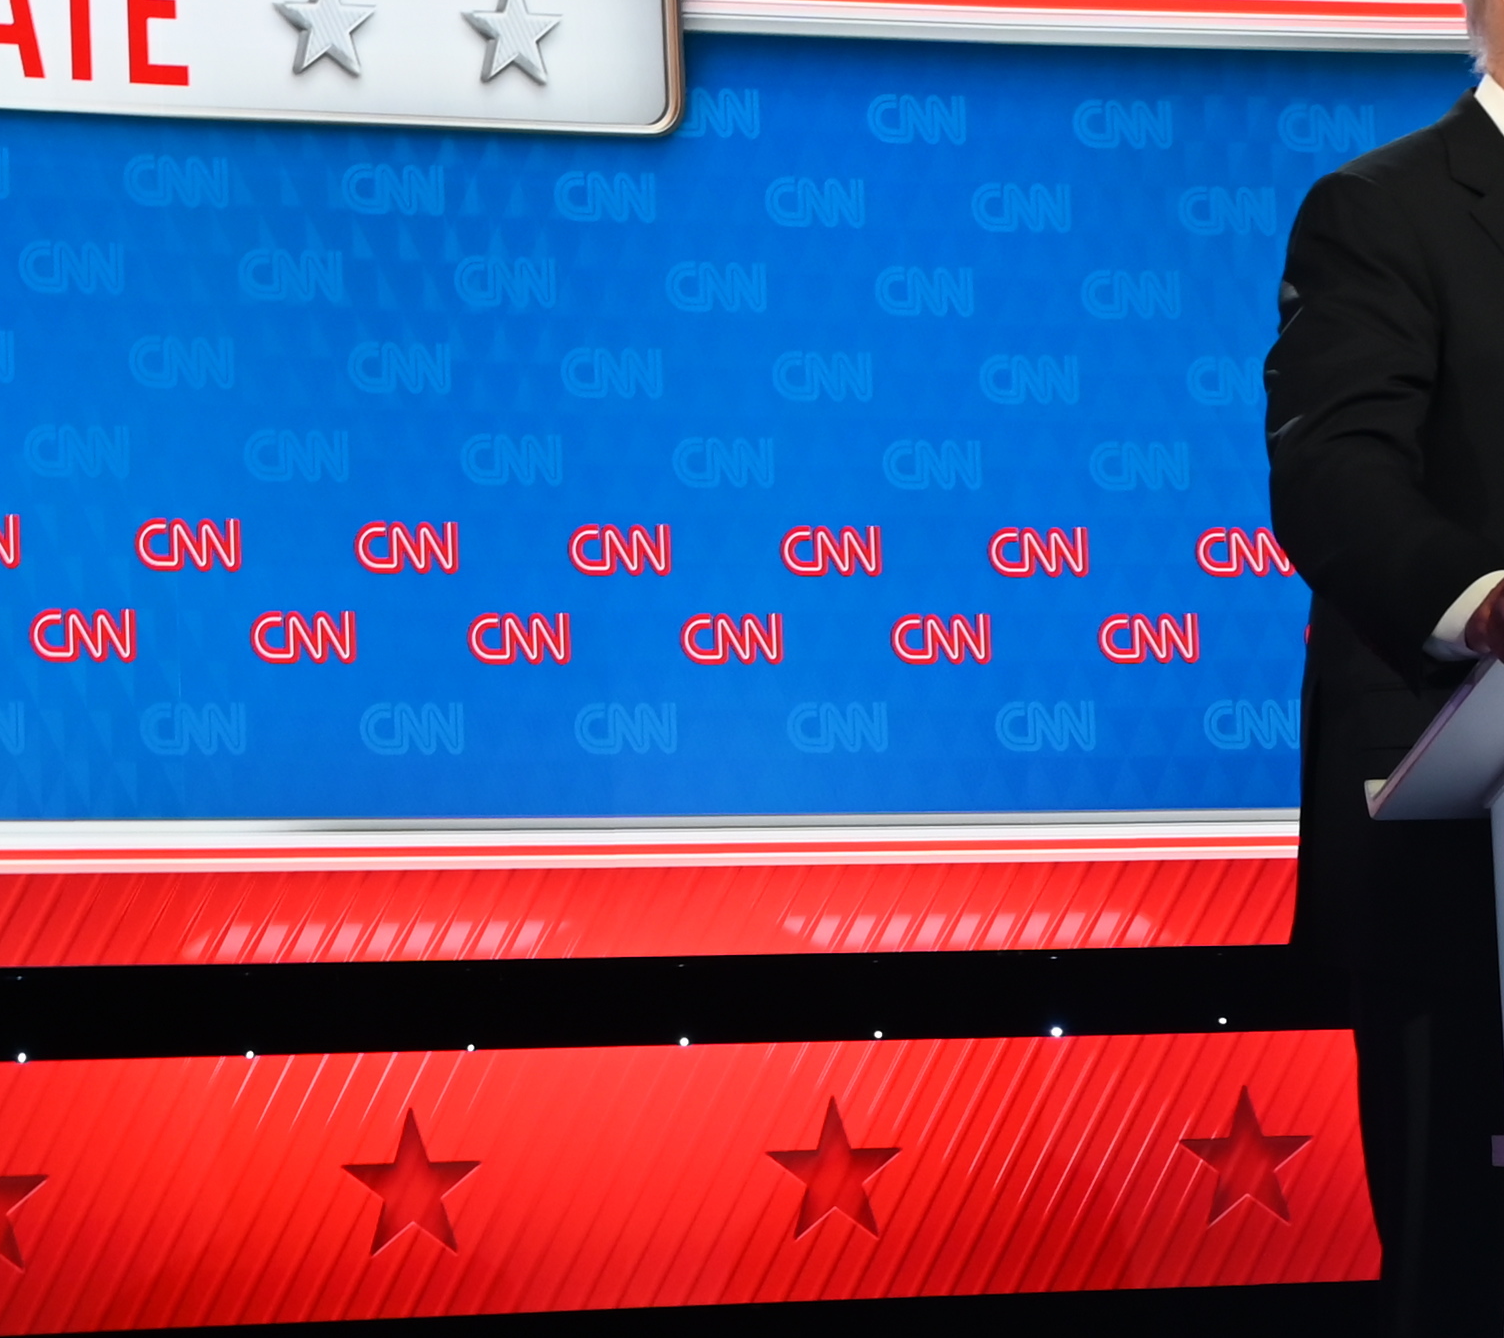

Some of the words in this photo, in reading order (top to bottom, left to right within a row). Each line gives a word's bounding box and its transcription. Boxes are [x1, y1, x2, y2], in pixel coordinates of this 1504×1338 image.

[867, 92, 966, 146] CNN
[1073, 99, 1172, 149] CNN
[1278, 102, 1375, 152] CNN
[123, 154, 229, 209] CNN
[341, 163, 445, 216] CNN
[554, 170, 656, 224] CNN
[765, 176, 865, 229] CNN
[972, 182, 1071, 234] CNN
[1178, 186, 1276, 236] CNN
[19, 241, 124, 296] CNN
[238, 249, 343, 303] CNN
[454, 256, 557, 309] CNN
[665, 262, 767, 313] CNN
[875, 266, 974, 317] CNN
[1081, 270, 1180, 320] CNN
[128, 336, 235, 390] CNN
[347, 341, 451, 396] CNN
[560, 348, 663, 399] CNN
[772, 352, 872, 404] CNN
[979, 356, 1080, 406] CNN
[23, 424, 130, 479] CNN
[243, 429, 349, 484] CNN
[461, 434, 562, 487] CNN
[672, 438, 774, 489] CNN
[883, 440, 982, 491] CNN
[1089, 441, 1189, 491] CNN
[134, 517, 241, 572] CNN
[354, 520, 458, 573] CNN
[568, 523, 671, 576] CNN
[780, 525, 882, 577] CNN
[987, 526, 1088, 578] CNN
[29, 608, 136, 662] CNN
[250, 611, 356, 664] CNN
[467, 612, 571, 665] CNN
[679, 612, 783, 665] CNN
[890, 613, 992, 664] CNN
[1097, 612, 1199, 663] CNN
[140, 702, 247, 756] CNN
[359, 702, 464, 756] CNN
[574, 702, 677, 756] CNN
[787, 702, 889, 753] CNN
[996, 701, 1096, 752] CNN
[1203, 699, 1300, 751] CNN
